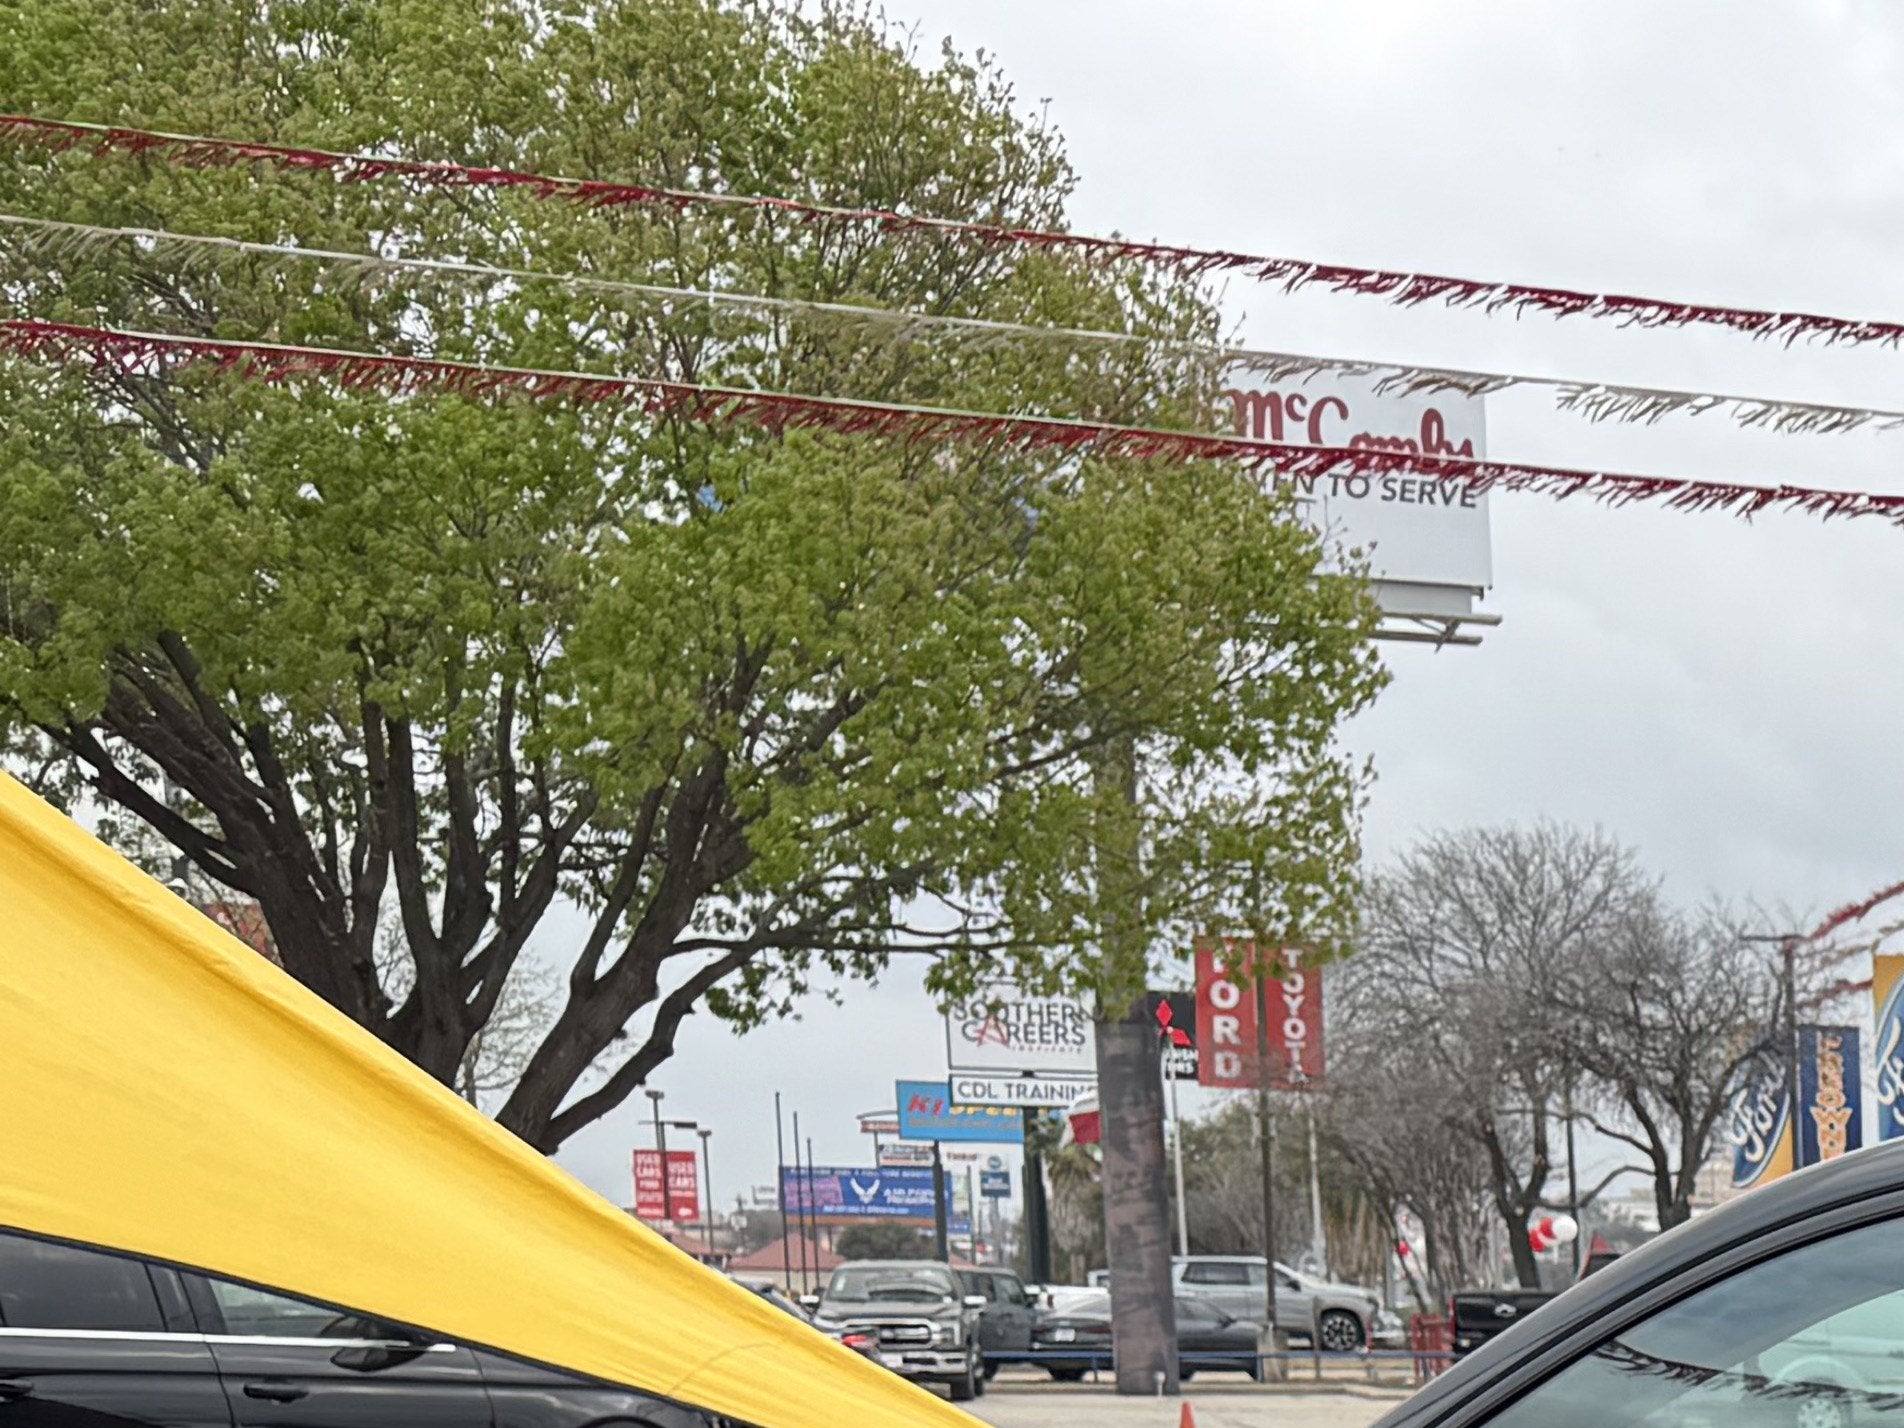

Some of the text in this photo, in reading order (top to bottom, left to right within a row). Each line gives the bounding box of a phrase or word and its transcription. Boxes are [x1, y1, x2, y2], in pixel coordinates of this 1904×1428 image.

[1327, 473, 1371, 499] TO
[1381, 477, 1477, 508] SERVE
[962, 1013, 1086, 1047] CAREERS
[958, 1082, 997, 1098] CDL
